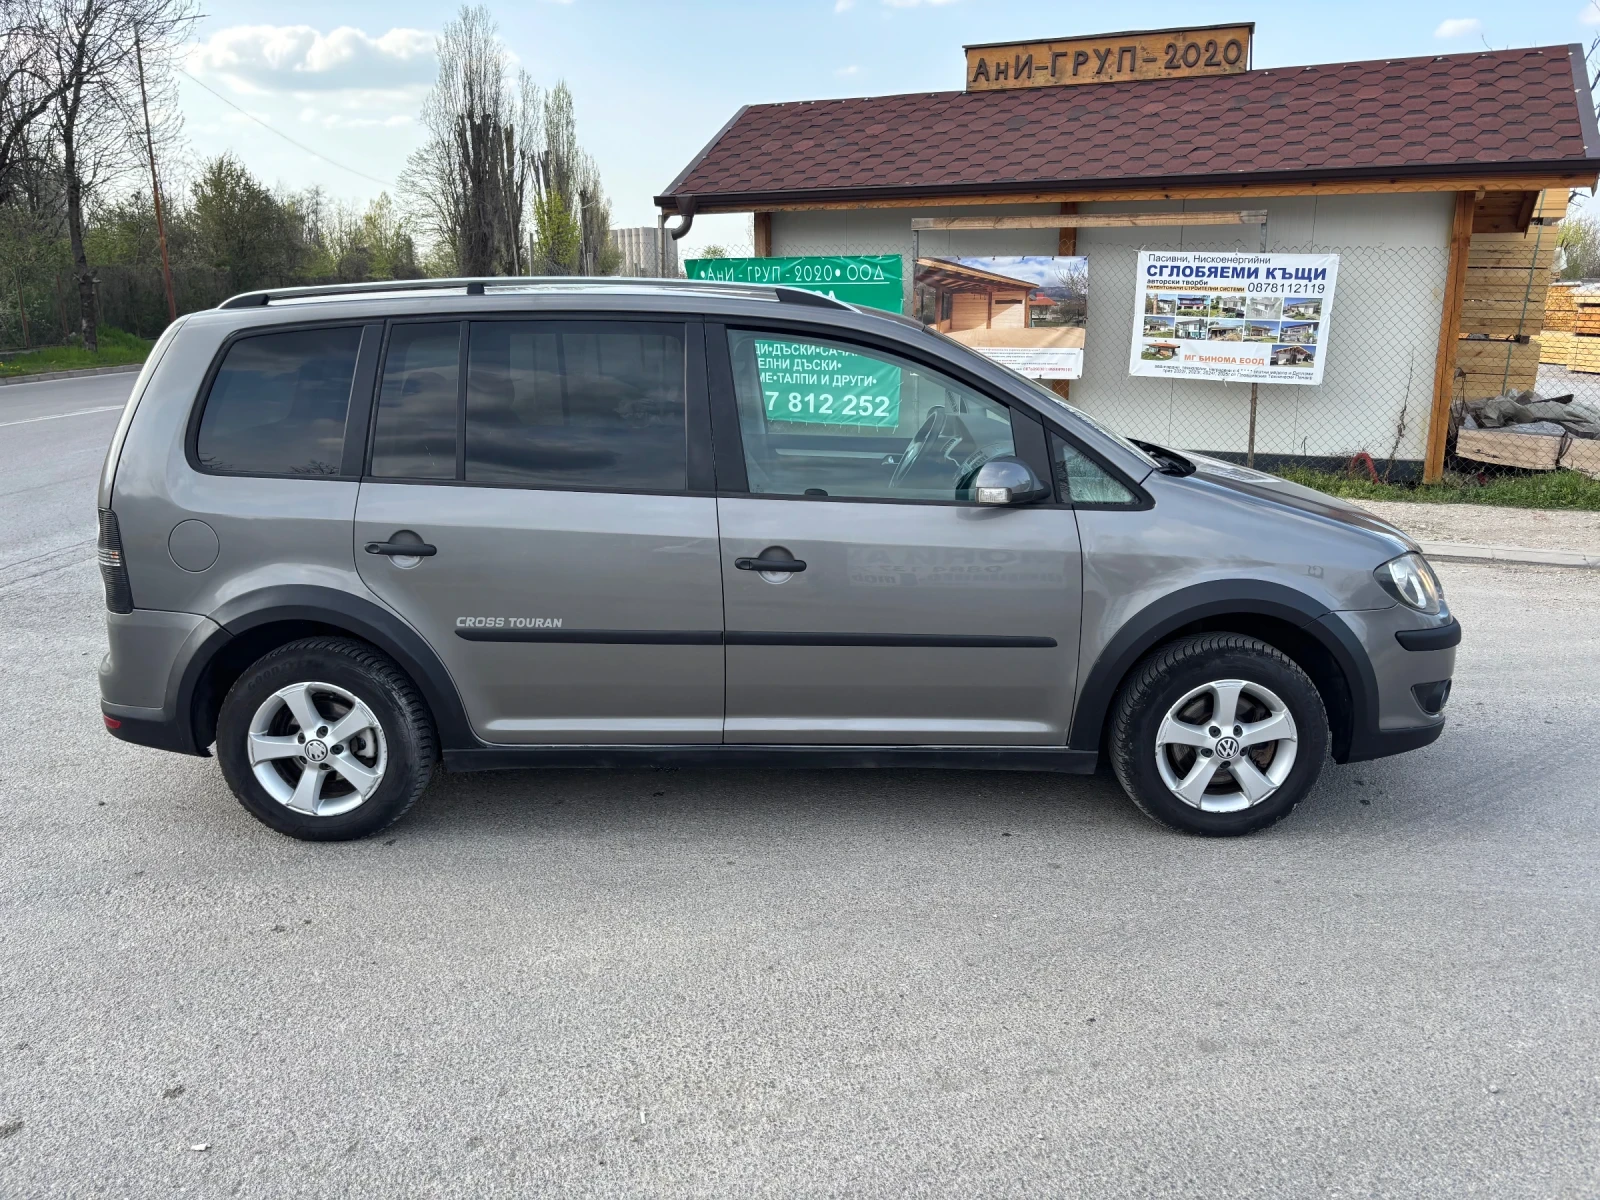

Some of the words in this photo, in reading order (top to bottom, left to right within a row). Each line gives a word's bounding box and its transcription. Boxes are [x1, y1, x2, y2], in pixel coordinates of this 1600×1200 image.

[1148, 253, 1190, 264] Пасивни,
[1193, 254, 1271, 265] Нискоенергийни
[747, 266, 781, 282] ГРУП
[1146, 264, 1260, 279] СГЛОБЯЕМИ
[1265, 267, 1327, 282] КЪЩИ
[1247, 282, 1326, 294] 0878112119
[1199, 355, 1237, 364] БИНОМА
[1239, 357, 1265, 366] ЕООД
[821, 375, 829, 385] И
[765, 392, 779, 411] 7
[788, 392, 833, 414] 812
[842, 395, 890, 417] 252
[456, 616, 505, 627] CROSS
[508, 617, 563, 628] TOURAN
